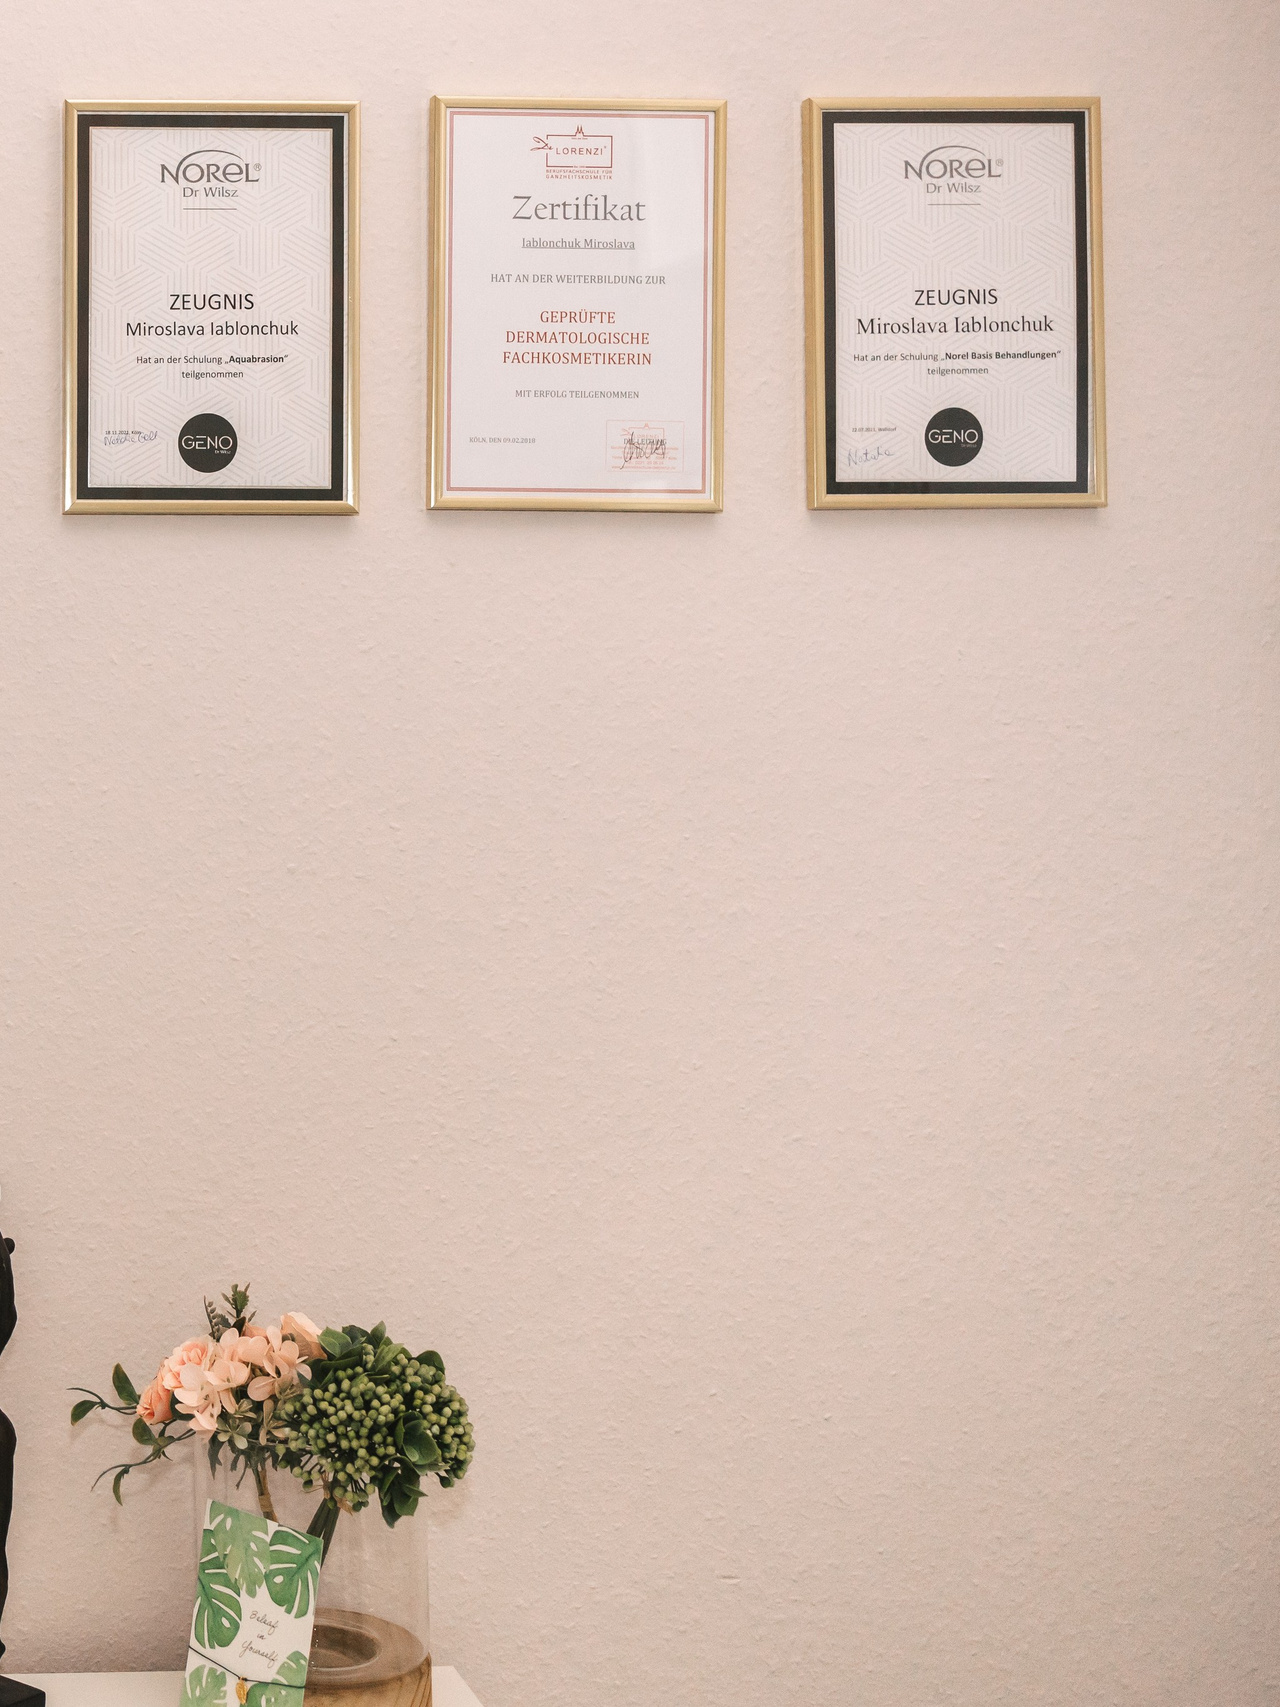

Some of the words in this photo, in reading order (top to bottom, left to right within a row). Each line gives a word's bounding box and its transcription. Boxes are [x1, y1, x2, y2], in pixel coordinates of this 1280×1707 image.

[183, 187, 199, 197] Dr
[204, 186, 238, 197] Wilsz
[927, 183, 942, 193] Dr
[947, 182, 981, 193] Wilsz
[513, 194, 645, 221] Zertifikat
[584, 238, 635, 249] Miroslava
[491, 274, 512, 282] HAT
[515, 274, 529, 282] AN
[533, 274, 553, 283] DER
[556, 275, 642, 284] WEITERBILDUNG
[645, 276, 665, 284] ZUR
[170, 294, 254, 310] ZEUGNIS
[915, 289, 997, 305] ZEUGNIS
[540, 309, 615, 323] GEPRÜFTE
[127, 322, 204, 336] Miroslava
[858, 318, 947, 334] Miroslava
[955, 315, 1053, 332] Iablonchuk
[506, 331, 649, 344] DERMATOLOGISCHE
[184, 356, 222, 365] Schulung
[504, 352, 651, 364] FACHKOSMETIKERIN
[901, 353, 938, 362] Schulung
[182, 370, 243, 380] teilgenommen
[928, 367, 988, 376] teilgenommen
[182, 436, 232, 449] GENO
[929, 430, 978, 443] GENO
